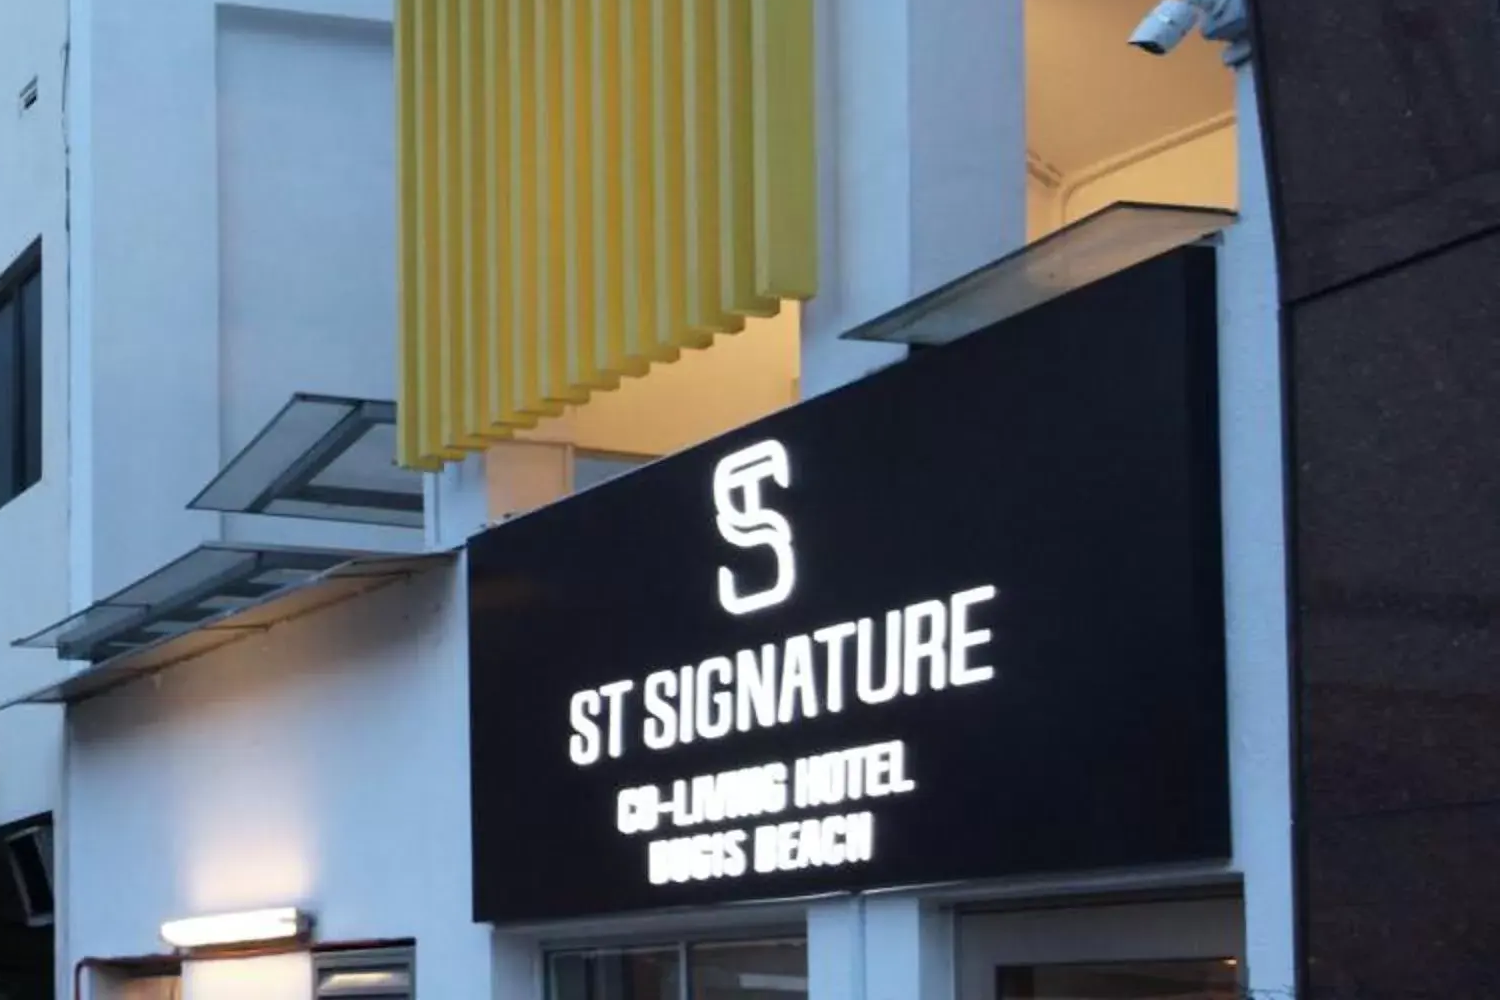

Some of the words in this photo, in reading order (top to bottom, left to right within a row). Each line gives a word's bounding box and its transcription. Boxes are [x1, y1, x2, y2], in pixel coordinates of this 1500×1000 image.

[569, 679, 635, 766] ST
[643, 584, 997, 750] SIGNATURE
[616, 761, 789, 835] CO-LIVING
[793, 739, 916, 809] HOTEL
[753, 810, 875, 874] BEACH
